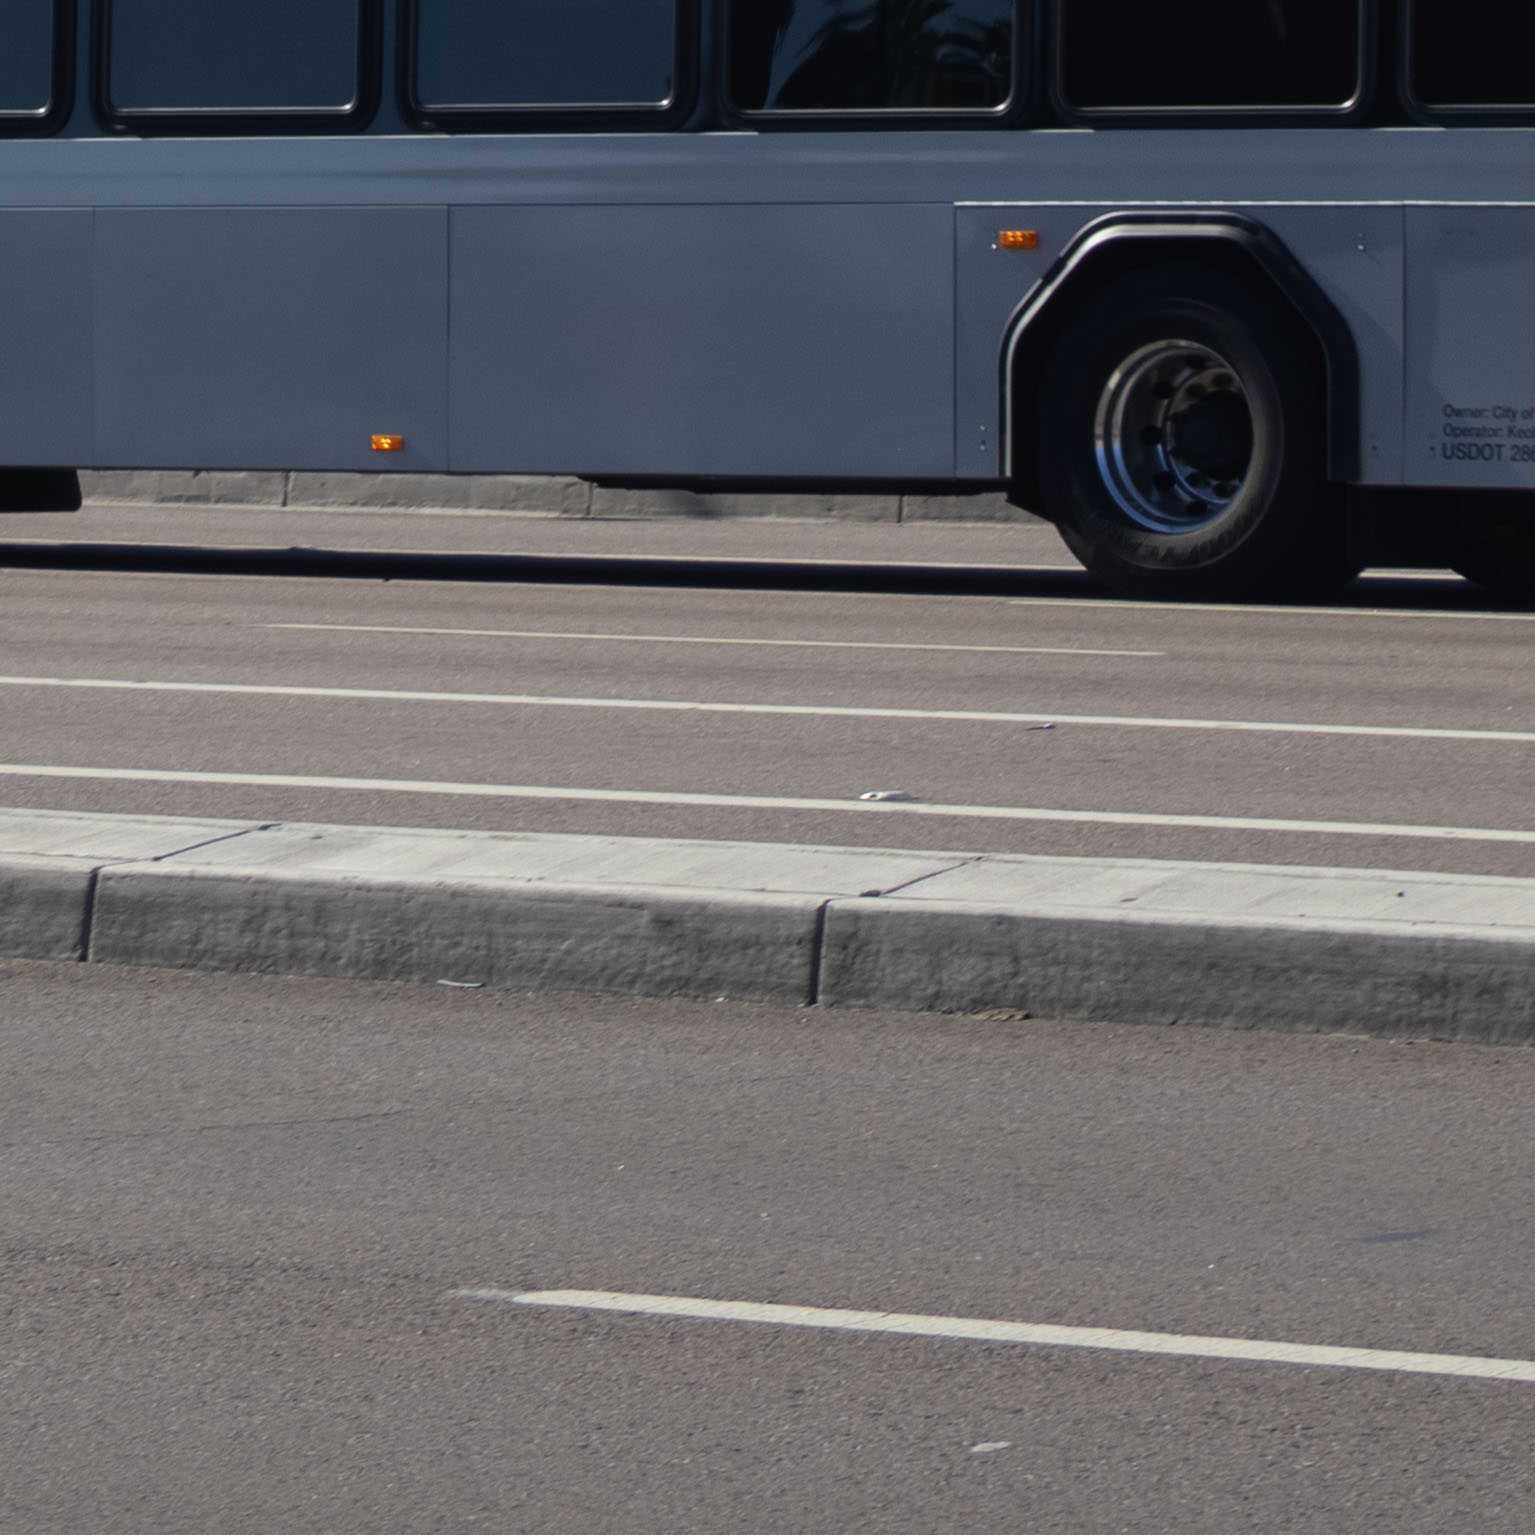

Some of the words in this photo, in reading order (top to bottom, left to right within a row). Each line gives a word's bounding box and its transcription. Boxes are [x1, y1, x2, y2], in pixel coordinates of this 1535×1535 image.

[1492, 405, 1517, 422] City
[1521, 407, 1535, 420] of
[1441, 442, 1506, 461] USDOT
